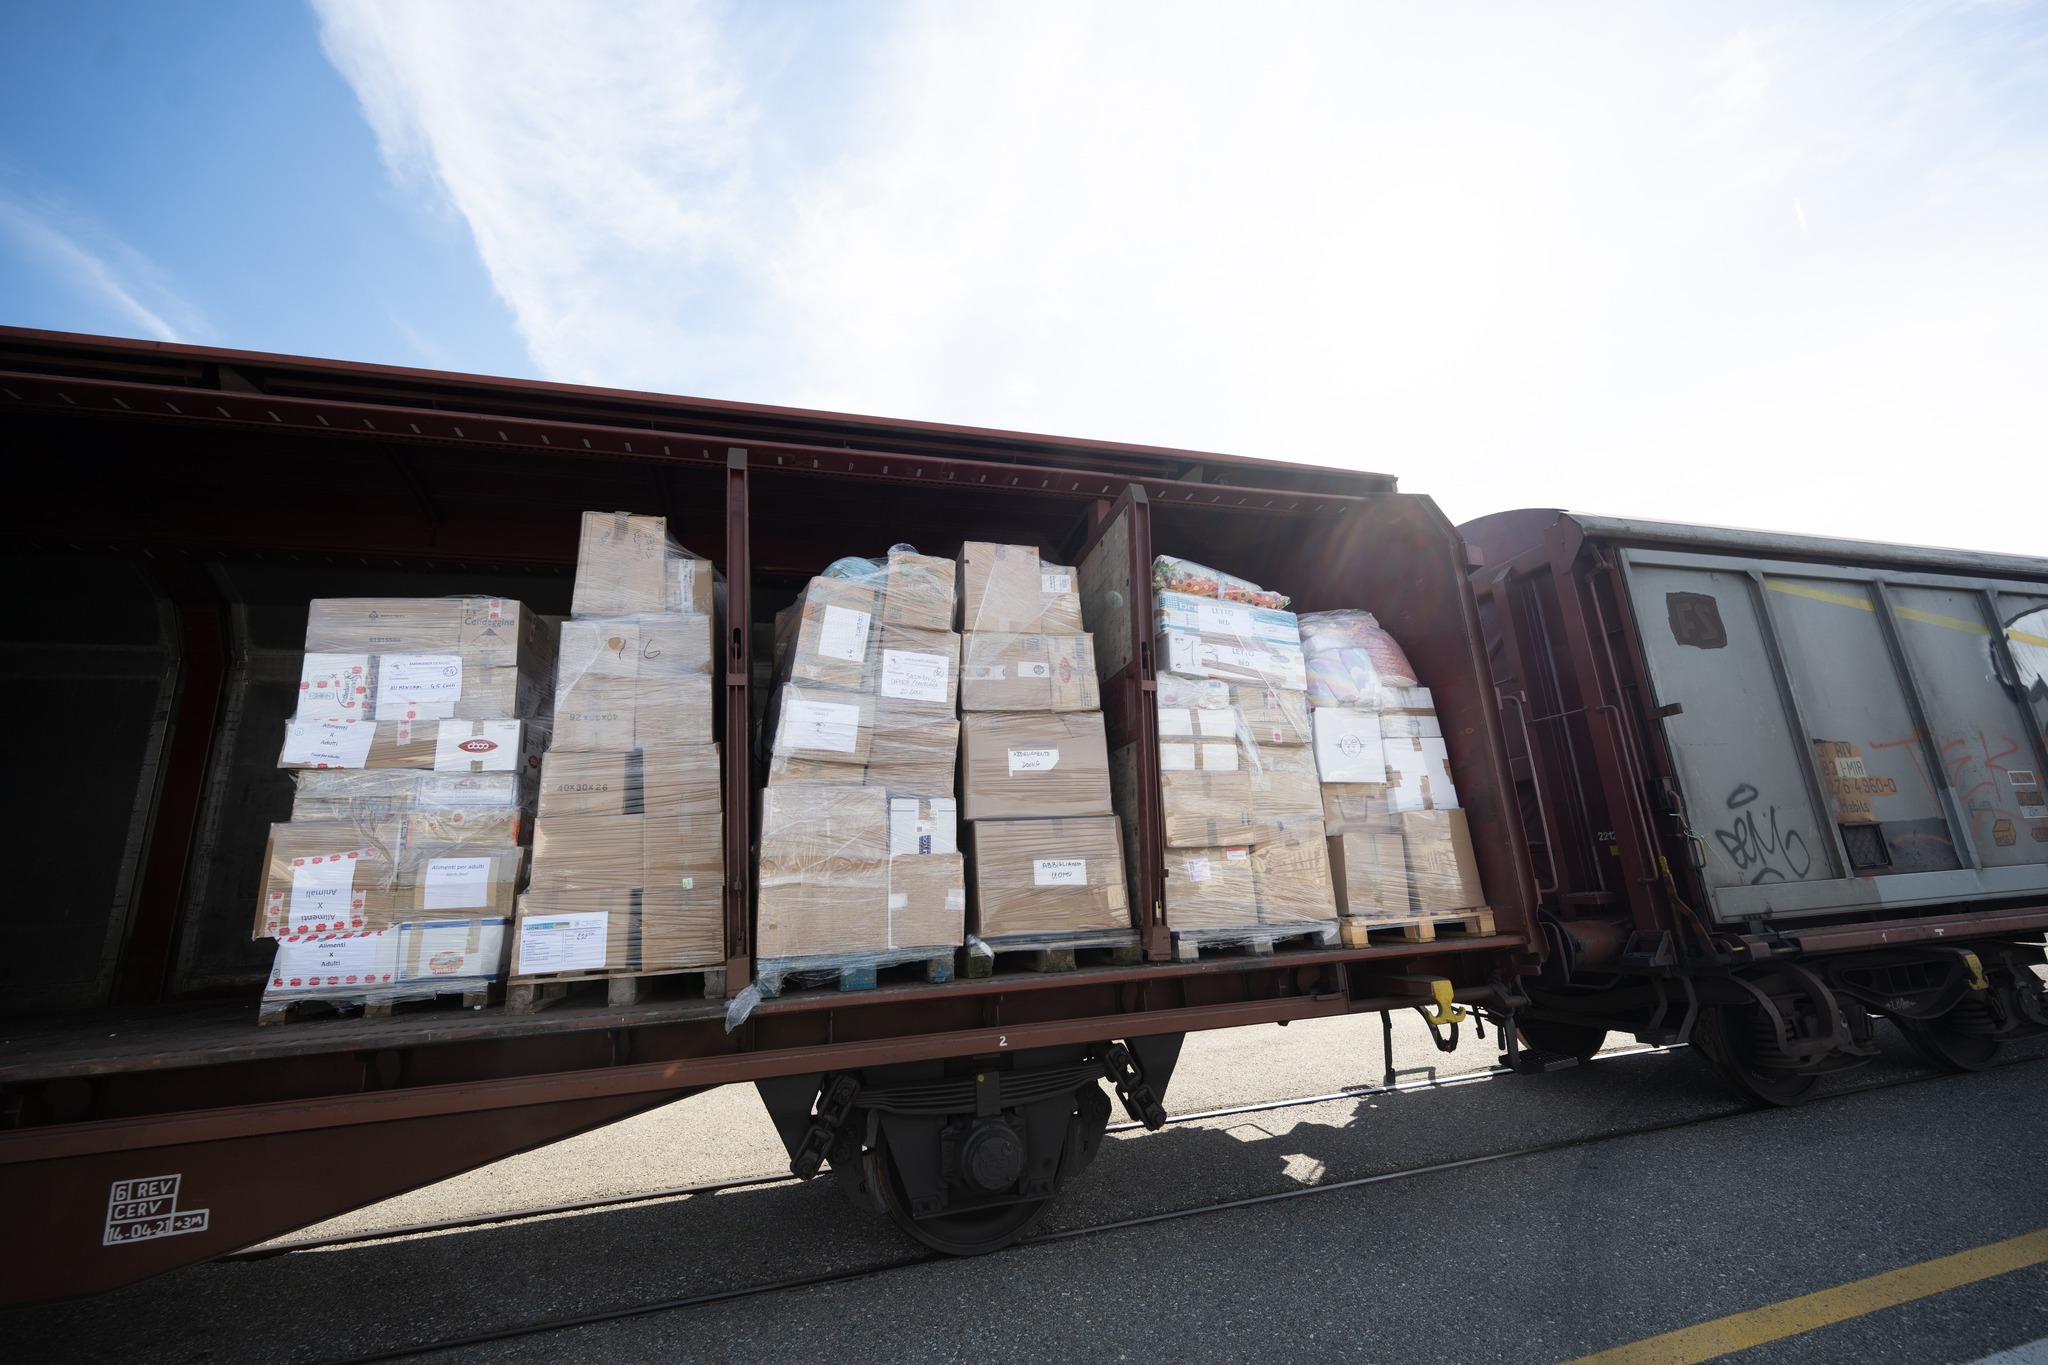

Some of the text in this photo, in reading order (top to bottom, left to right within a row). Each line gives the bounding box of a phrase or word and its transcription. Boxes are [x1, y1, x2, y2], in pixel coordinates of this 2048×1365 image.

[1212, 608, 1234, 617] LETTO
[464, 618, 515, 628] Candeggina
[1676, 603, 1718, 640] FS
[1232, 648, 1254, 657] LETTO
[1835, 742, 1853, 758] RIV
[1854, 778, 1897, 794] 4960-0
[1051, 871, 1073, 879] UOMO
[306, 889, 337, 897] Animali
[301, 914, 336, 922] Alimenti
[999, 1035, 1008, 1047] 2
[116, 1180, 173, 1200] 6 REV
[114, 1200, 162, 1220] CERV
[108, 1220, 170, 1242] 14-04-21
